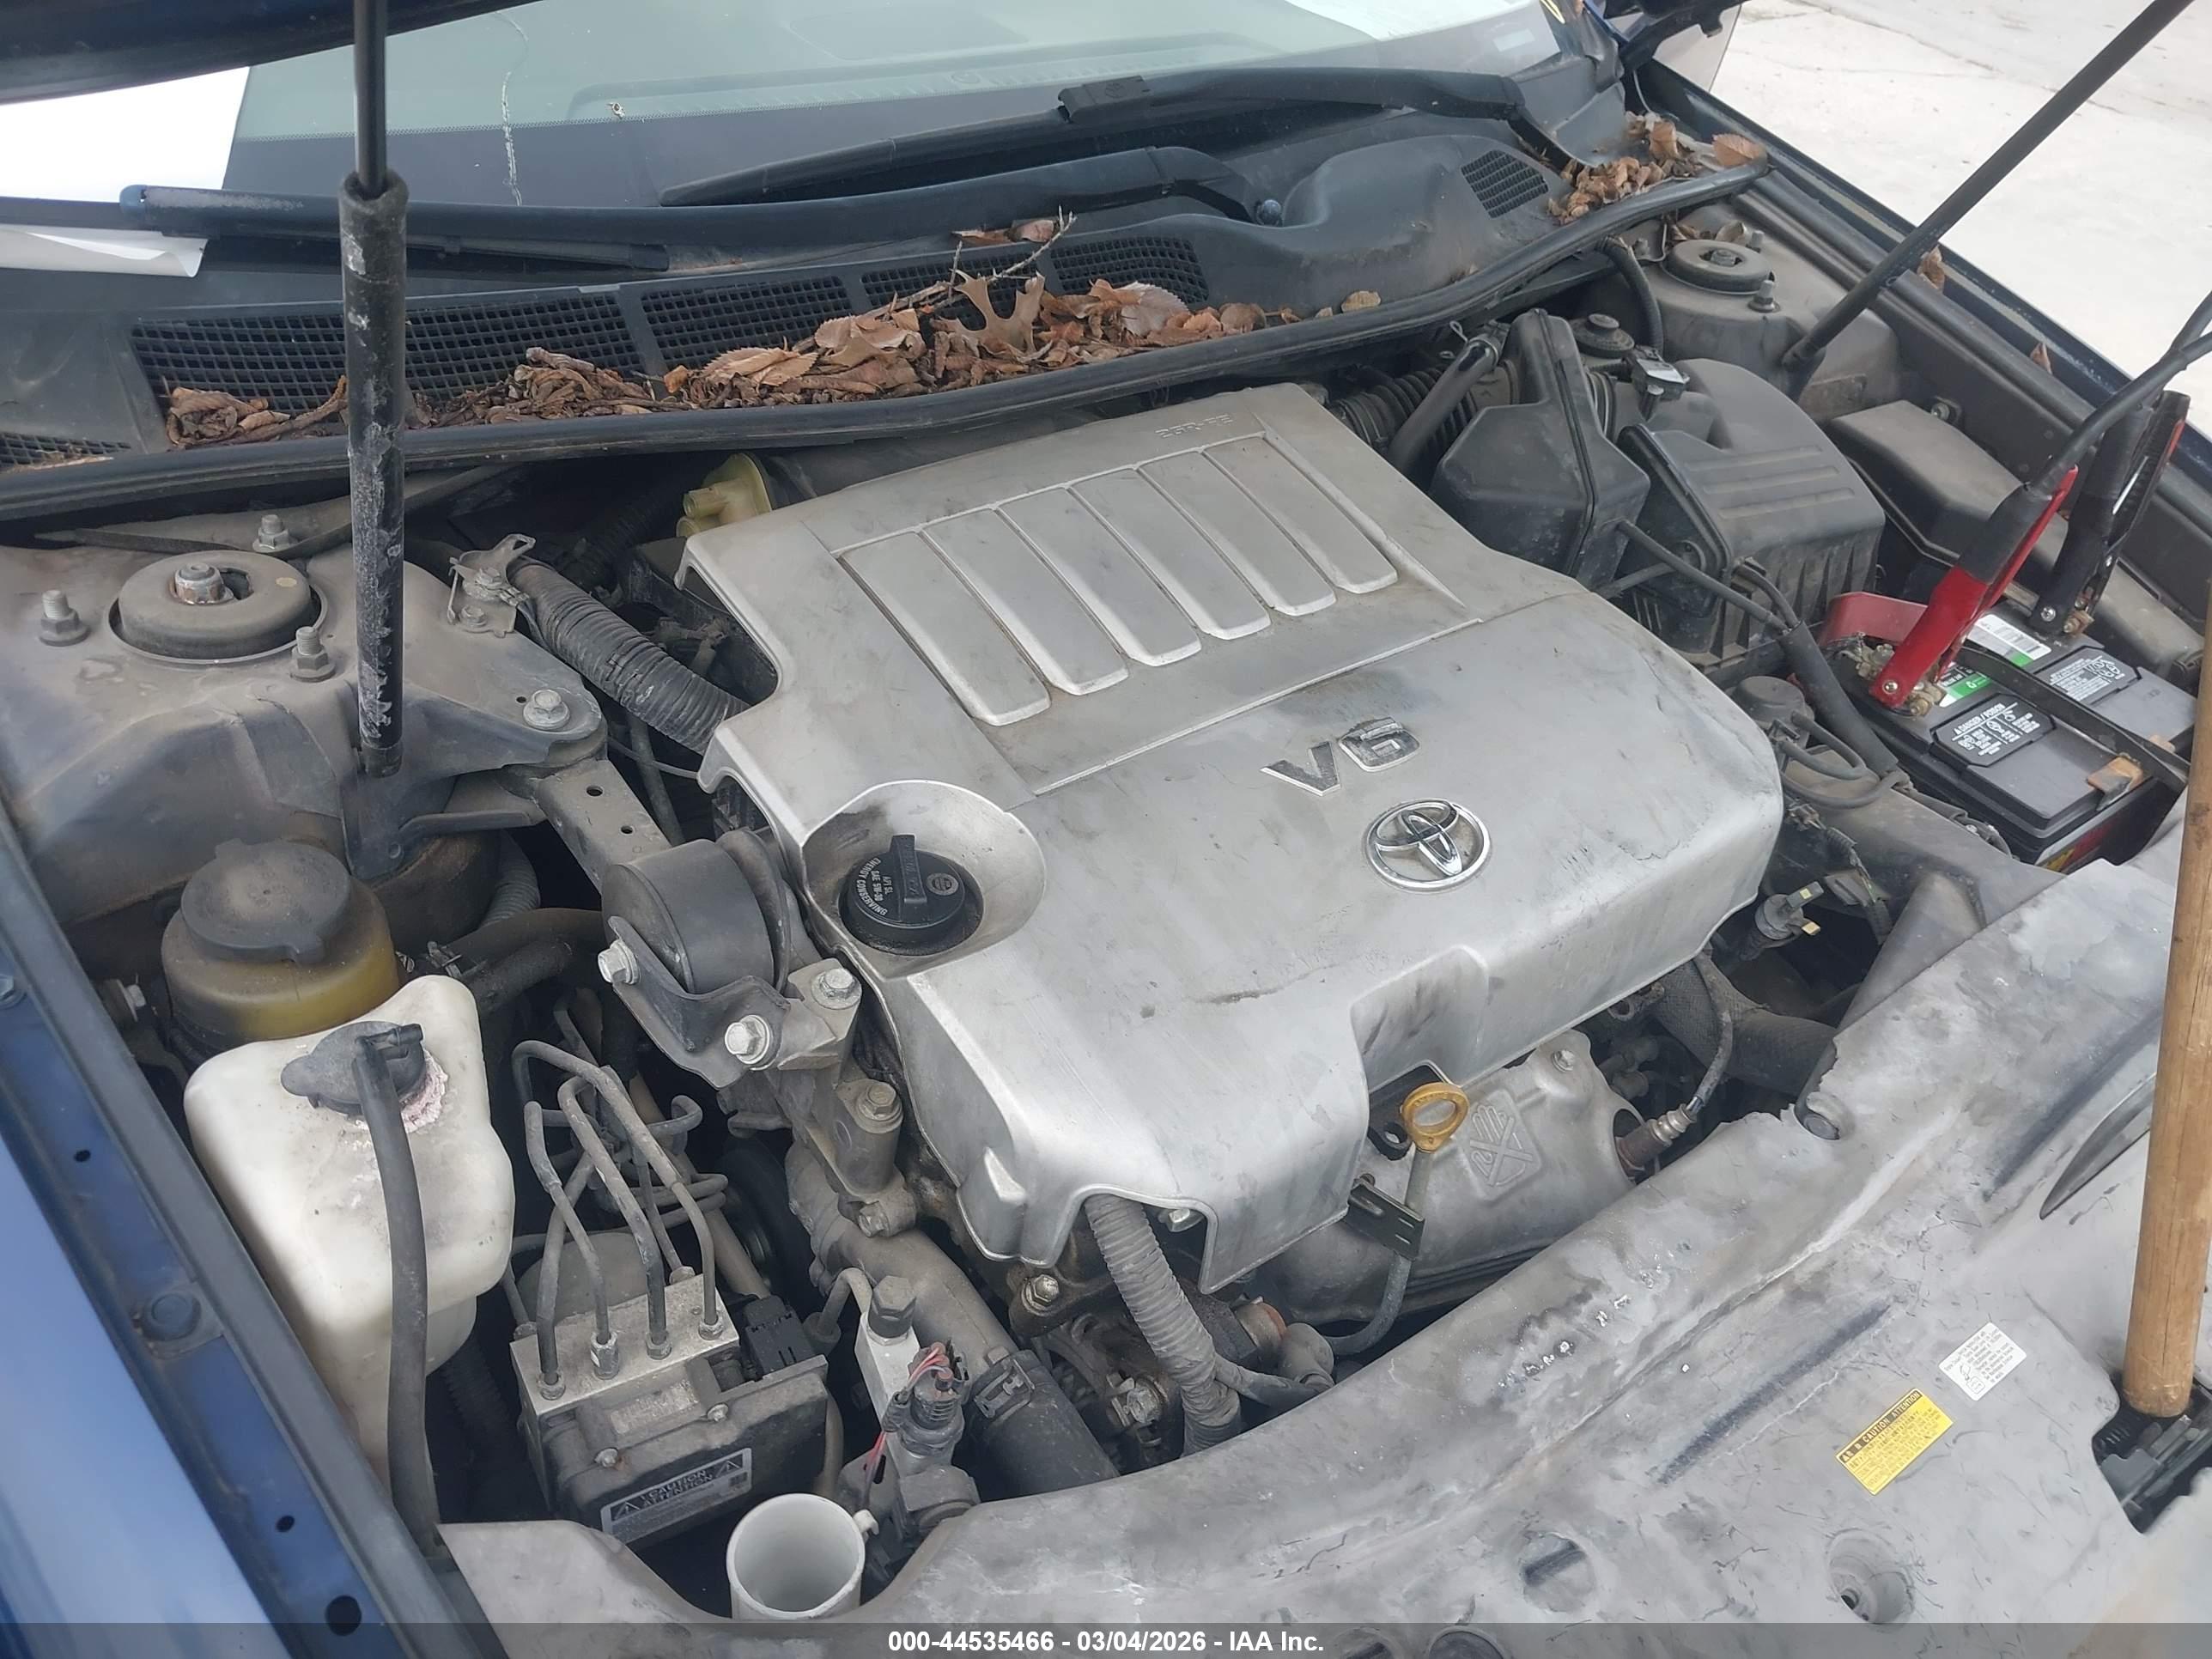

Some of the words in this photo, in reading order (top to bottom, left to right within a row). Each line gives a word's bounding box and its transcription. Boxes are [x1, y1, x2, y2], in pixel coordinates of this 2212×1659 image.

[1260, 716, 1420, 797] V6
[859, 857, 881, 879] ENERGY
[856, 879, 888, 915] CONSERVING
[1863, 1418, 1890, 1443] CAUTION
[1891, 1391, 1920, 1418] ATTENTION
[643, 1474, 713, 1506] ATTENTION
[649, 1470, 706, 1498] CAUTION
